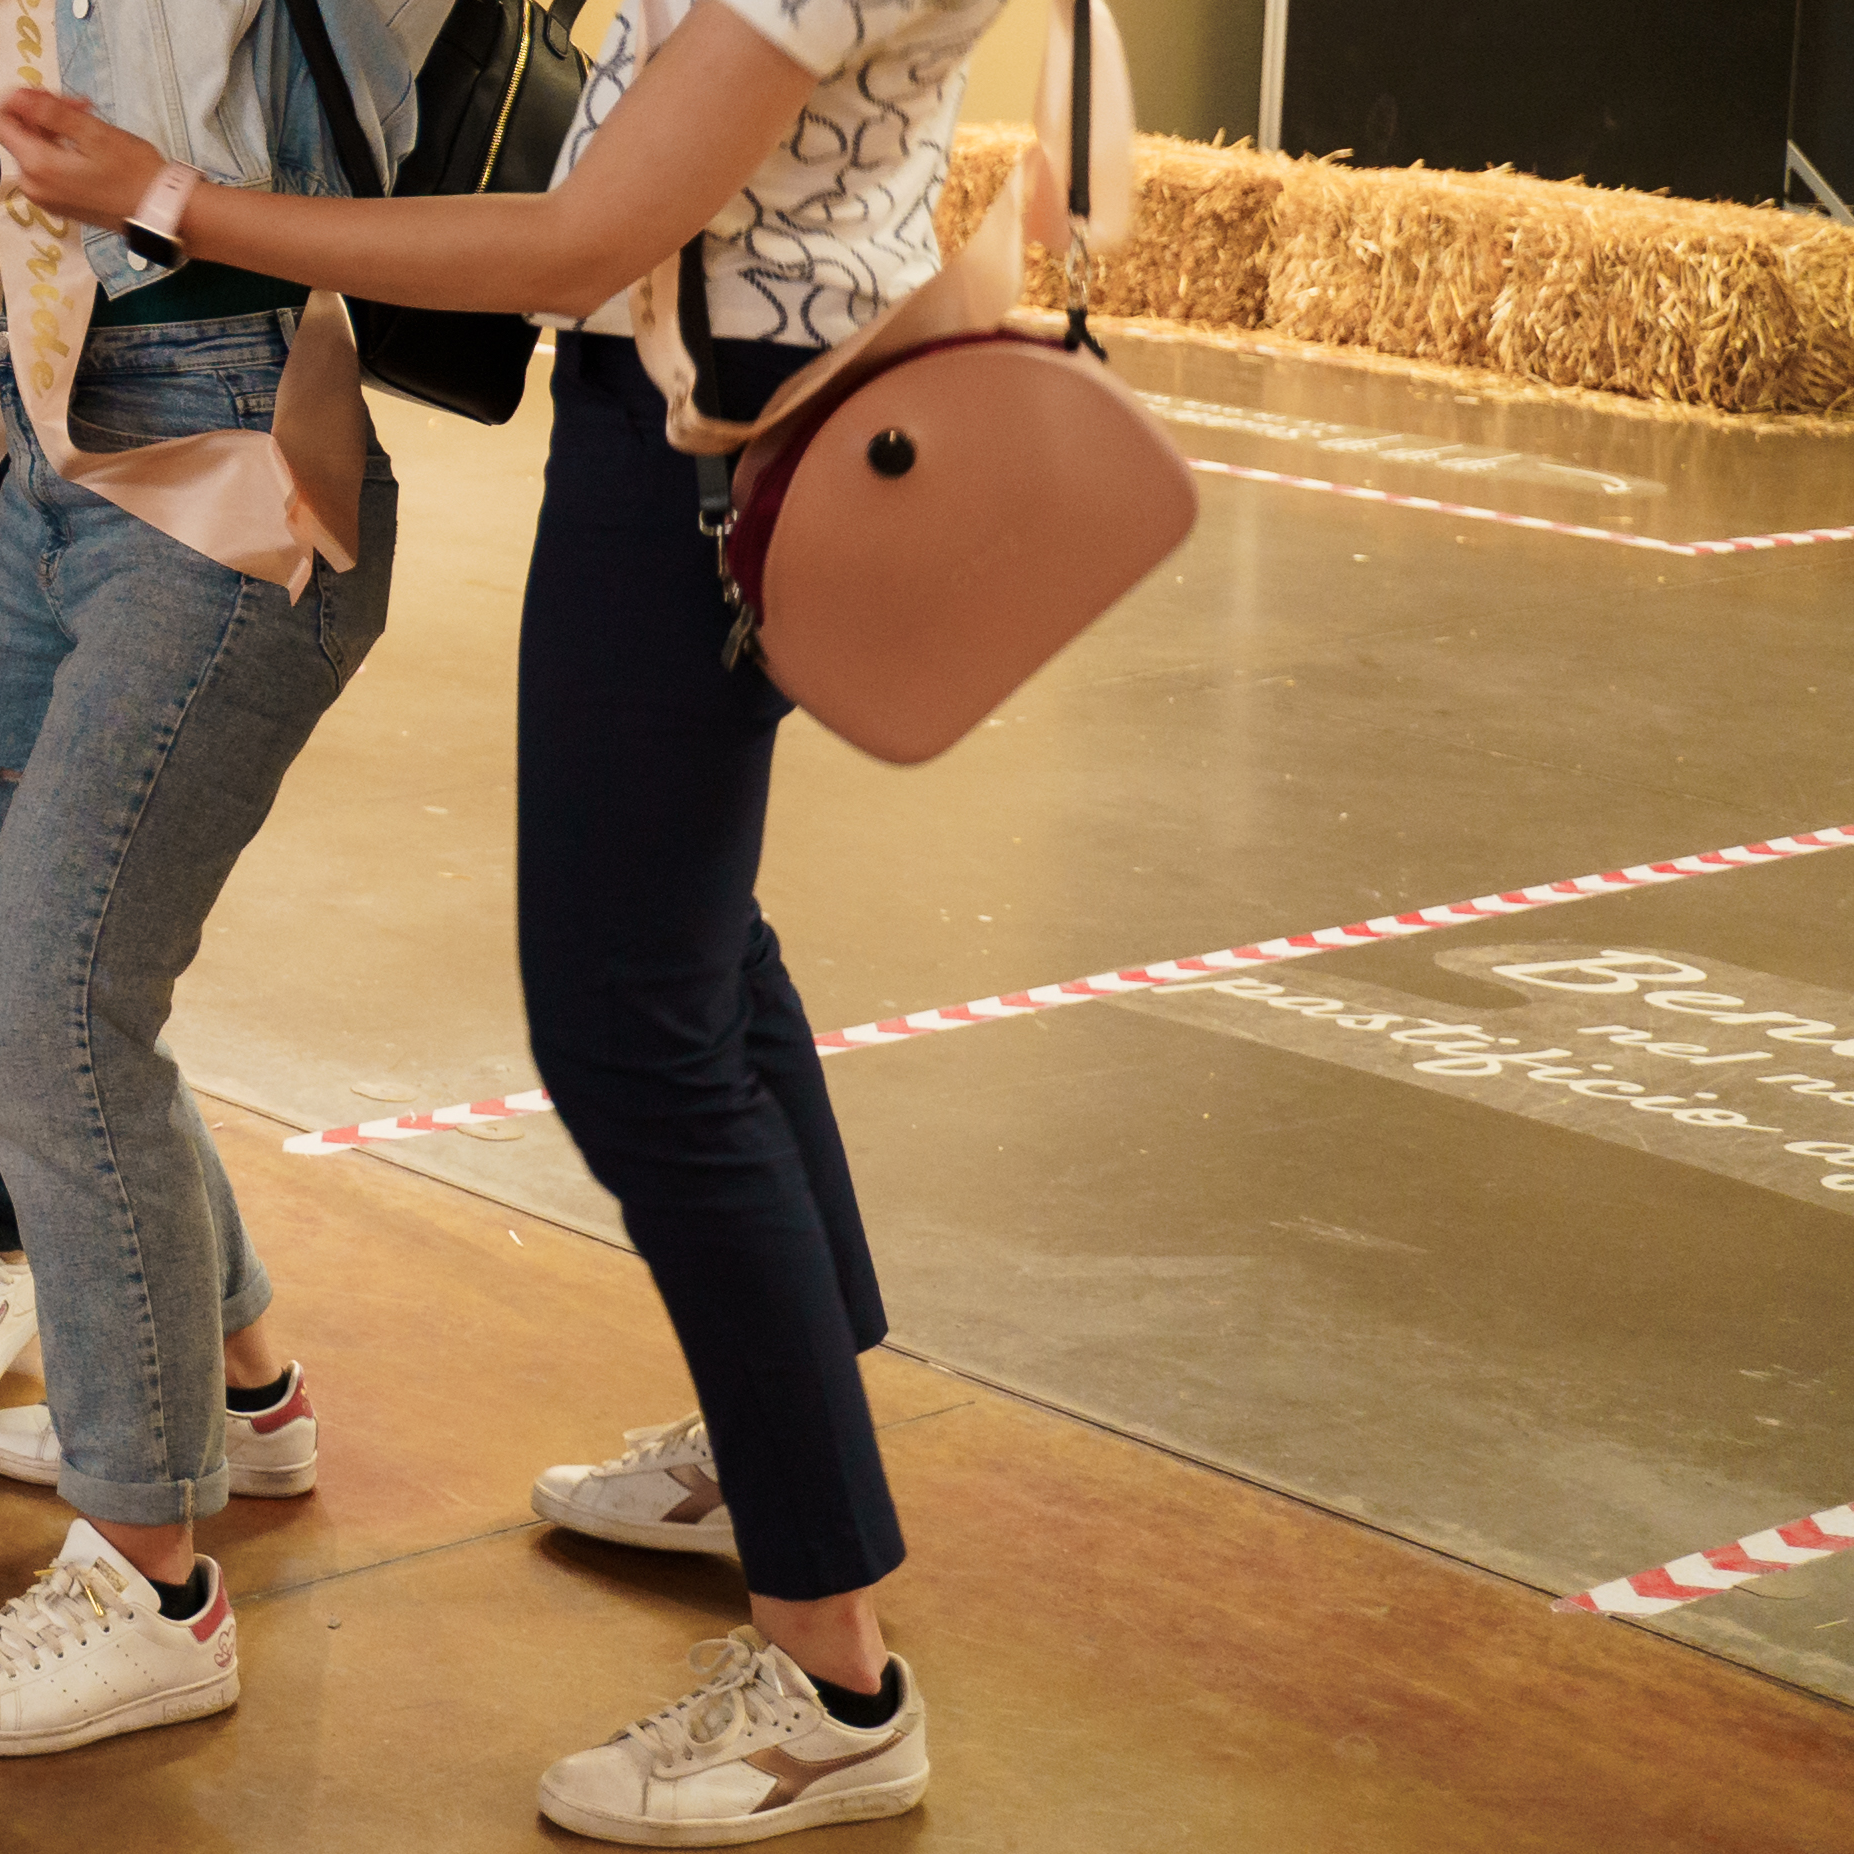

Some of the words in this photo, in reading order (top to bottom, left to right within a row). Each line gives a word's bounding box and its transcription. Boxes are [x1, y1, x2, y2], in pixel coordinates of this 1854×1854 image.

[5, 186, 75, 399] Bride
[1150, 977, 1784, 1133] pastificio
[1577, 1024, 1773, 1065] nel
